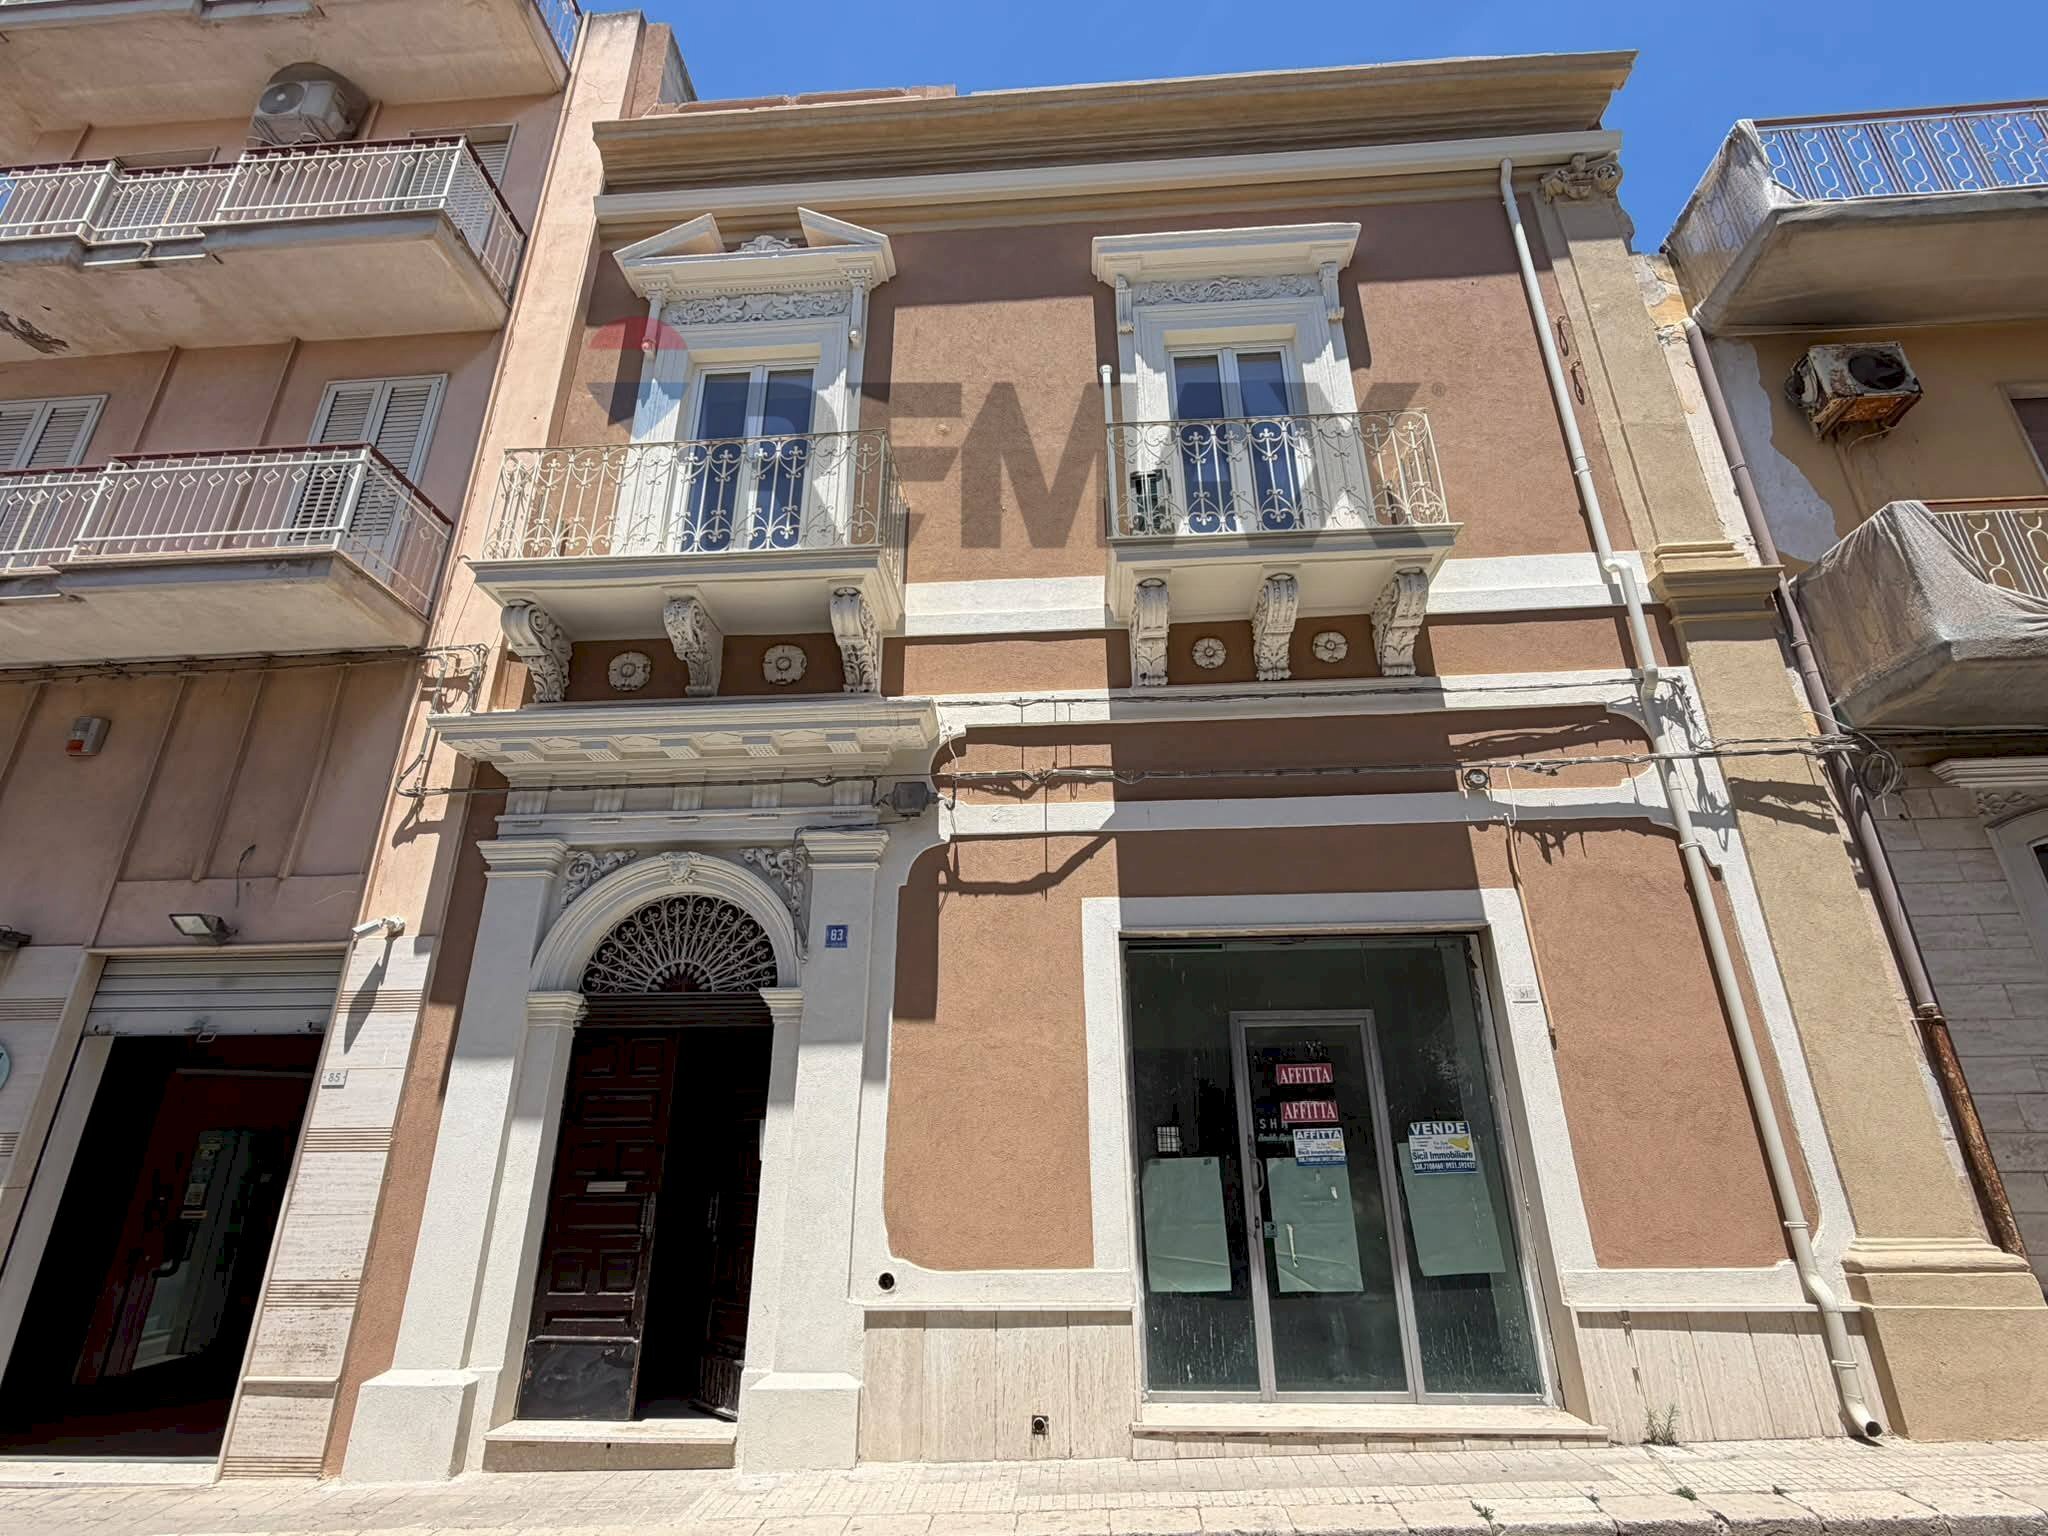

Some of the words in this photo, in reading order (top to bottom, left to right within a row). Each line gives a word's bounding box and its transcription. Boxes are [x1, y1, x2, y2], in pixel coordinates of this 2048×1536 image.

[831, 929, 843, 941] 83
[328, 1072, 341, 1082] 85
[1279, 1066, 1331, 1084] AFFITTA
[1284, 1102, 1337, 1120] AFFITTA
[1296, 1130, 1342, 1139] AFFITTA
[1410, 1122, 1466, 1136] VENDE
[1412, 1151, 1428, 1161] Sicil
